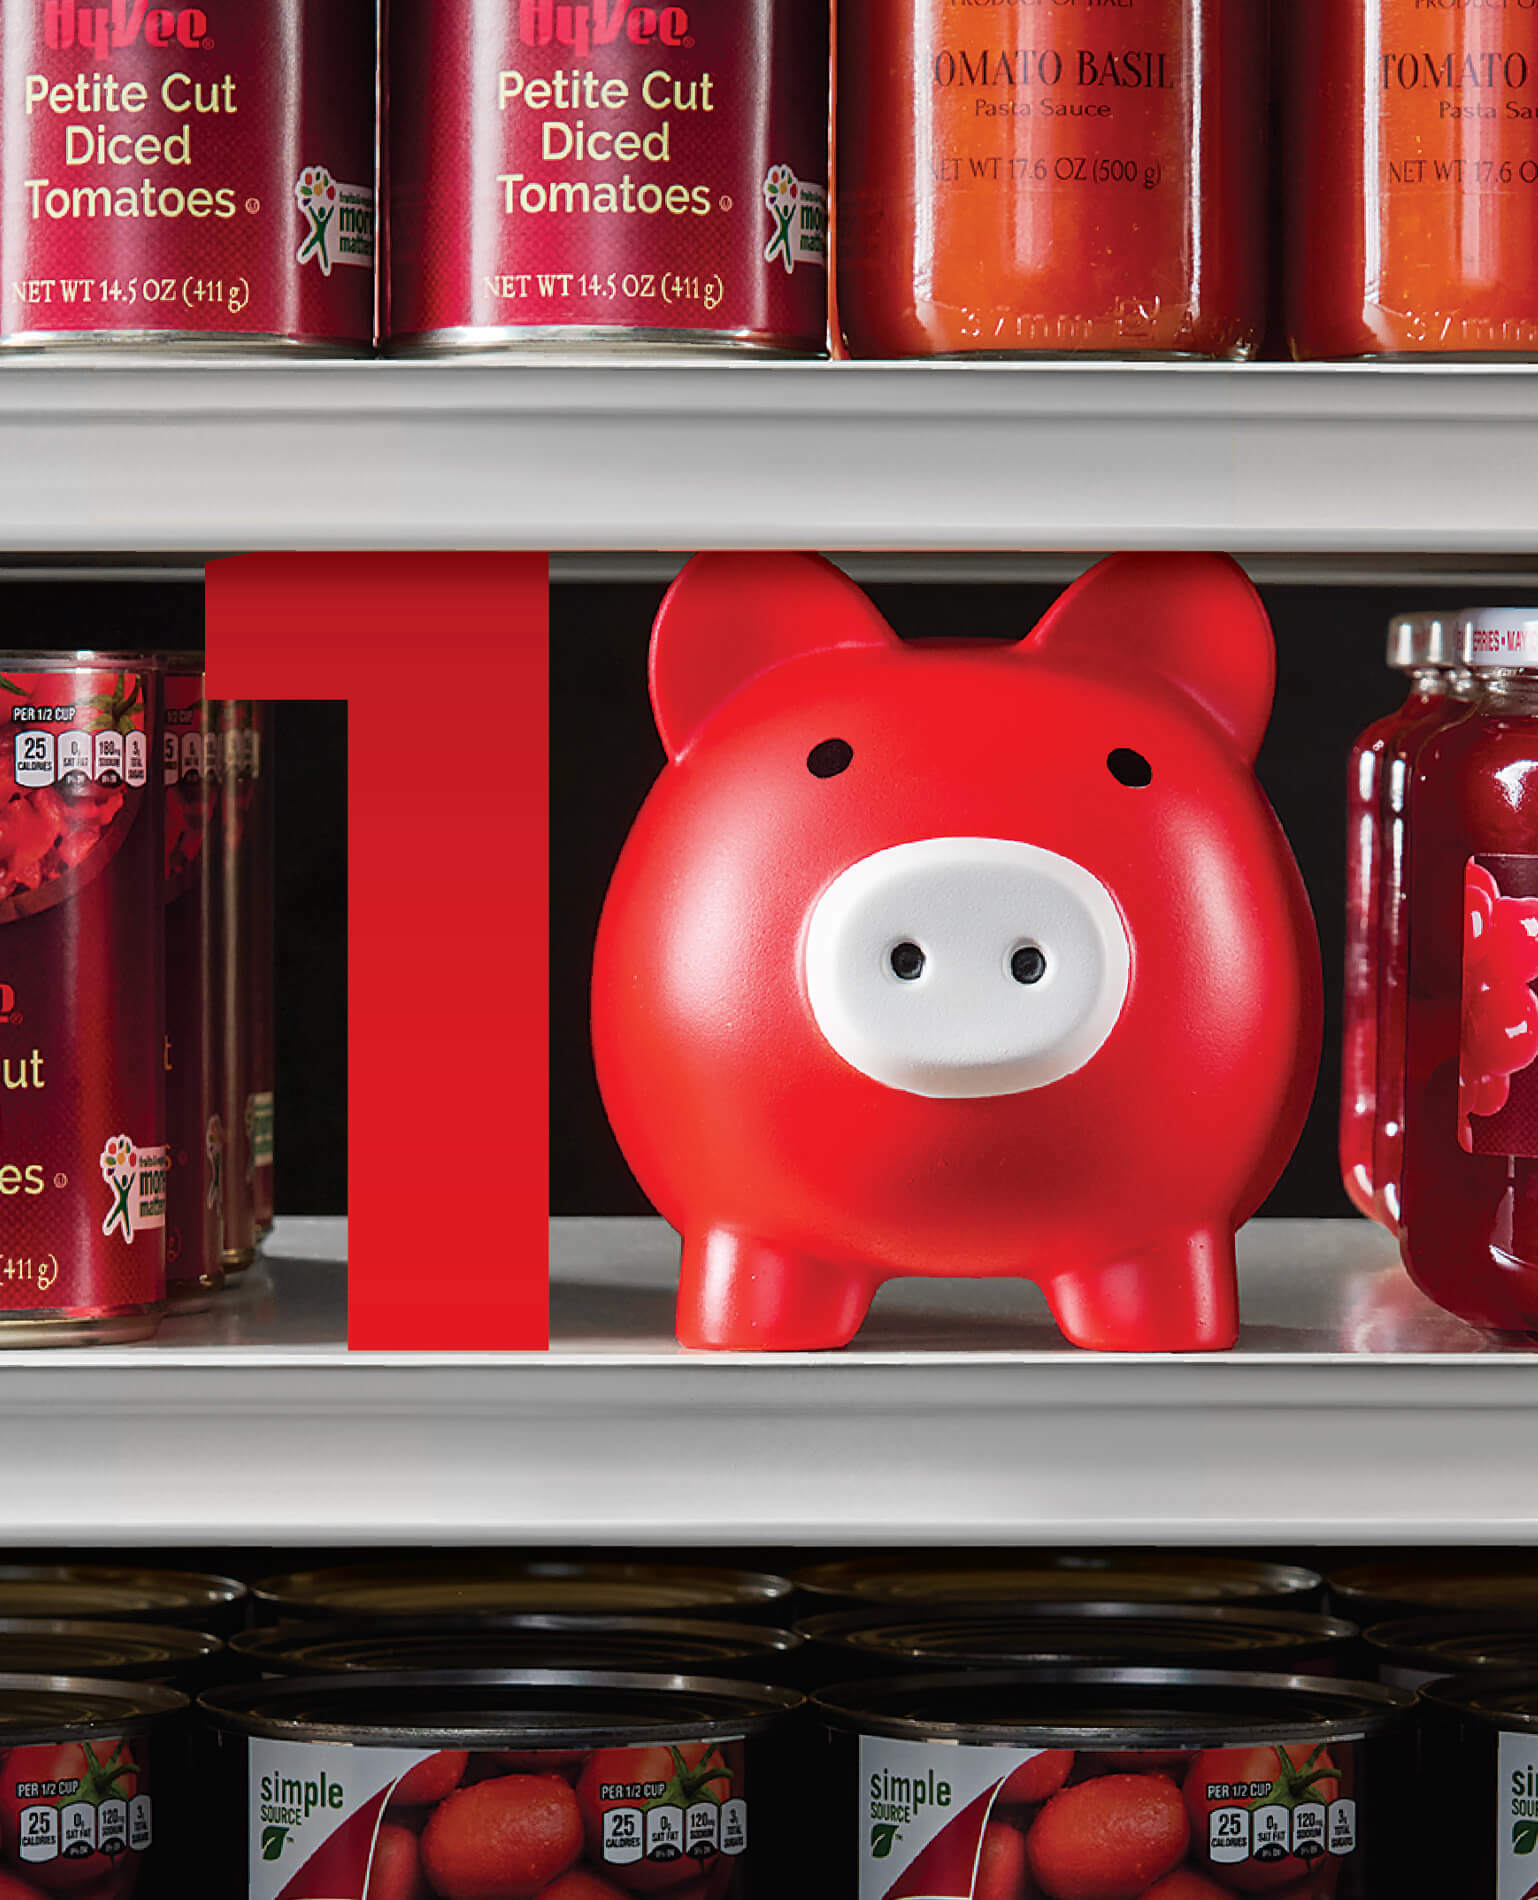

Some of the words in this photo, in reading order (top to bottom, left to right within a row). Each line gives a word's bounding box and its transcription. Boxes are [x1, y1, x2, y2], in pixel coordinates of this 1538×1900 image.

[935, 50, 1063, 88] OMATO
[1078, 51, 1174, 89] BASIL
[1379, 53, 1528, 90] TOMATO
[25, 73, 148, 115] Petite
[161, 73, 238, 113] Cut
[499, 70, 629, 111] Petite
[642, 70, 714, 112] Cut
[975, 99, 1031, 117] Pasta
[1041, 98, 1112, 117] Sauce
[1439, 101, 1497, 119] Pasta
[1506, 101, 1538, 119] Sa
[65, 124, 192, 166] Diced
[542, 121, 670, 162] Diced
[970, 158, 1002, 180] WT
[1010, 158, 1047, 181] 17.6
[1055, 158, 1087, 182] OZ
[1093, 158, 1138, 184] (500
[1144, 162, 1162, 189] g)
[1389, 160, 1427, 183] NET
[1434, 160, 1466, 183] WT
[1475, 160, 1512, 183] 17.6
[1520, 160, 1538, 184] O
[24, 179, 237, 219] Tomatoes
[496, 174, 711, 215] Tomatoes
[12, 279, 55, 303] NET
[60, 279, 95, 303] WT
[99, 278, 138, 304] 14.5
[142, 279, 177, 303] OZ
[182, 276, 223, 308] (411
[228, 277, 249, 313] g)
[484, 274, 531, 298] NET
[537, 274, 574, 298] WT
[578, 273, 617, 299] 14.5
[621, 274, 656, 298] OZ
[661, 272, 701, 303] (411
[704, 273, 724, 309] g)
[13, 706, 35, 721] PER
[37, 706, 53, 721] 1/2
[55, 706, 77, 721] CUP
[24, 737, 46, 759] 25
[37, 1253, 58, 1290] g)
[18, 1783, 39, 1798] PER
[41, 1782, 57, 1796] 1/2
[59, 1780, 79, 1795] CUP
[261, 1770, 342, 1815] simple
[601, 1784, 624, 1799] PER
[626, 1784, 641, 1798] 1/2
[643, 1783, 666, 1798] CUP
[870, 1768, 951, 1815] simple
[1207, 1784, 1230, 1799] PER
[1232, 1783, 1248, 1798] 1/2
[1250, 1782, 1273, 1797] CUP
[1512, 1764, 1538, 1798] si
[29, 1812, 51, 1835] 25
[260, 1804, 302, 1826] SOURCE
[613, 1814, 635, 1837] 25
[870, 1801, 911, 1823] SOURCE
[1218, 1814, 1241, 1836] 25
